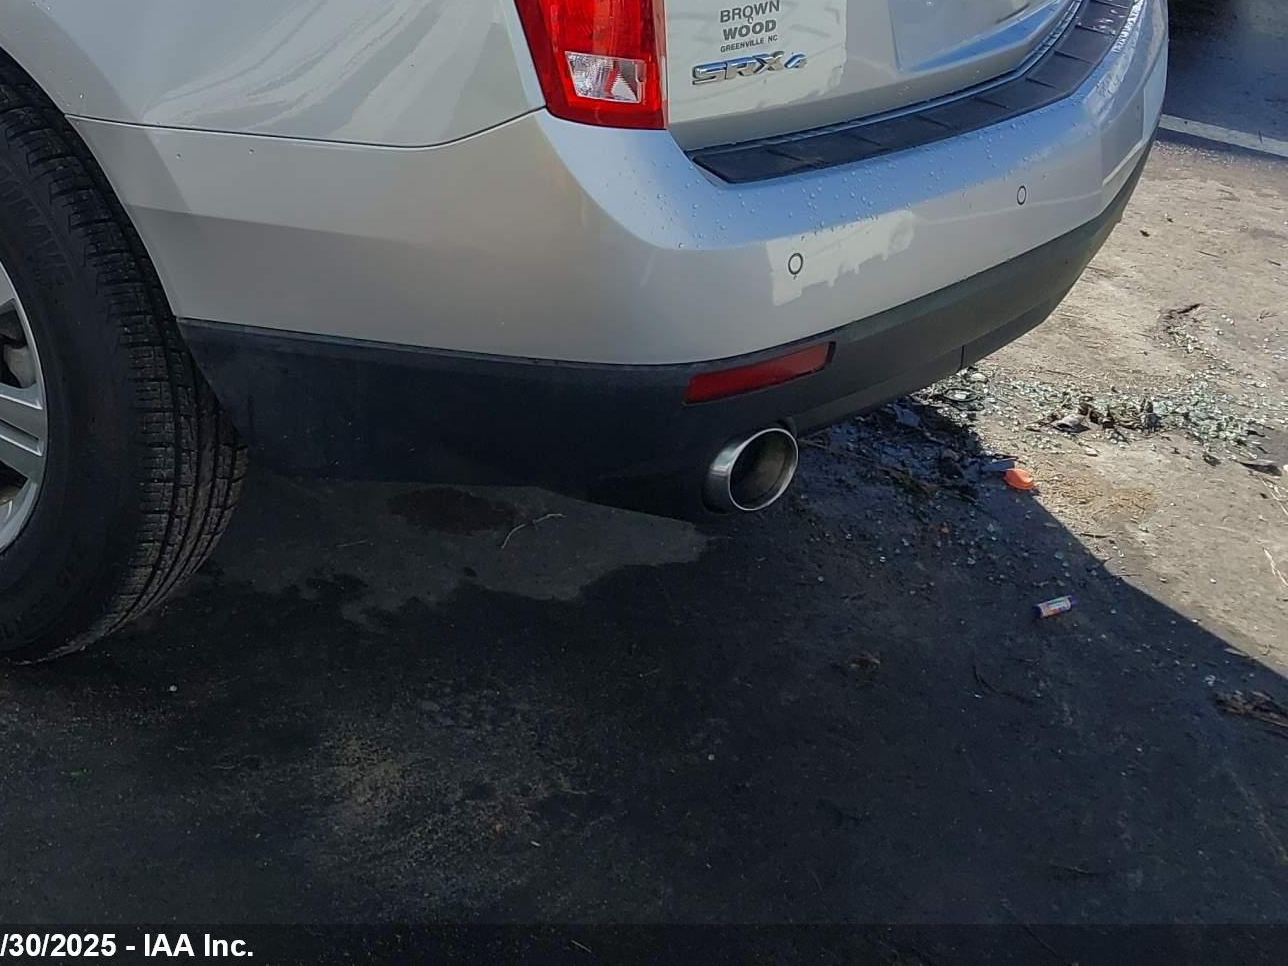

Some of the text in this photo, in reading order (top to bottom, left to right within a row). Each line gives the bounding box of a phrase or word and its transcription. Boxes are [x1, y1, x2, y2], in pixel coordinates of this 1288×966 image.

[720, 0, 780, 23] BROWN
[723, 19, 776, 41] WOOD
[720, 37, 764, 53] GREENVILLE
